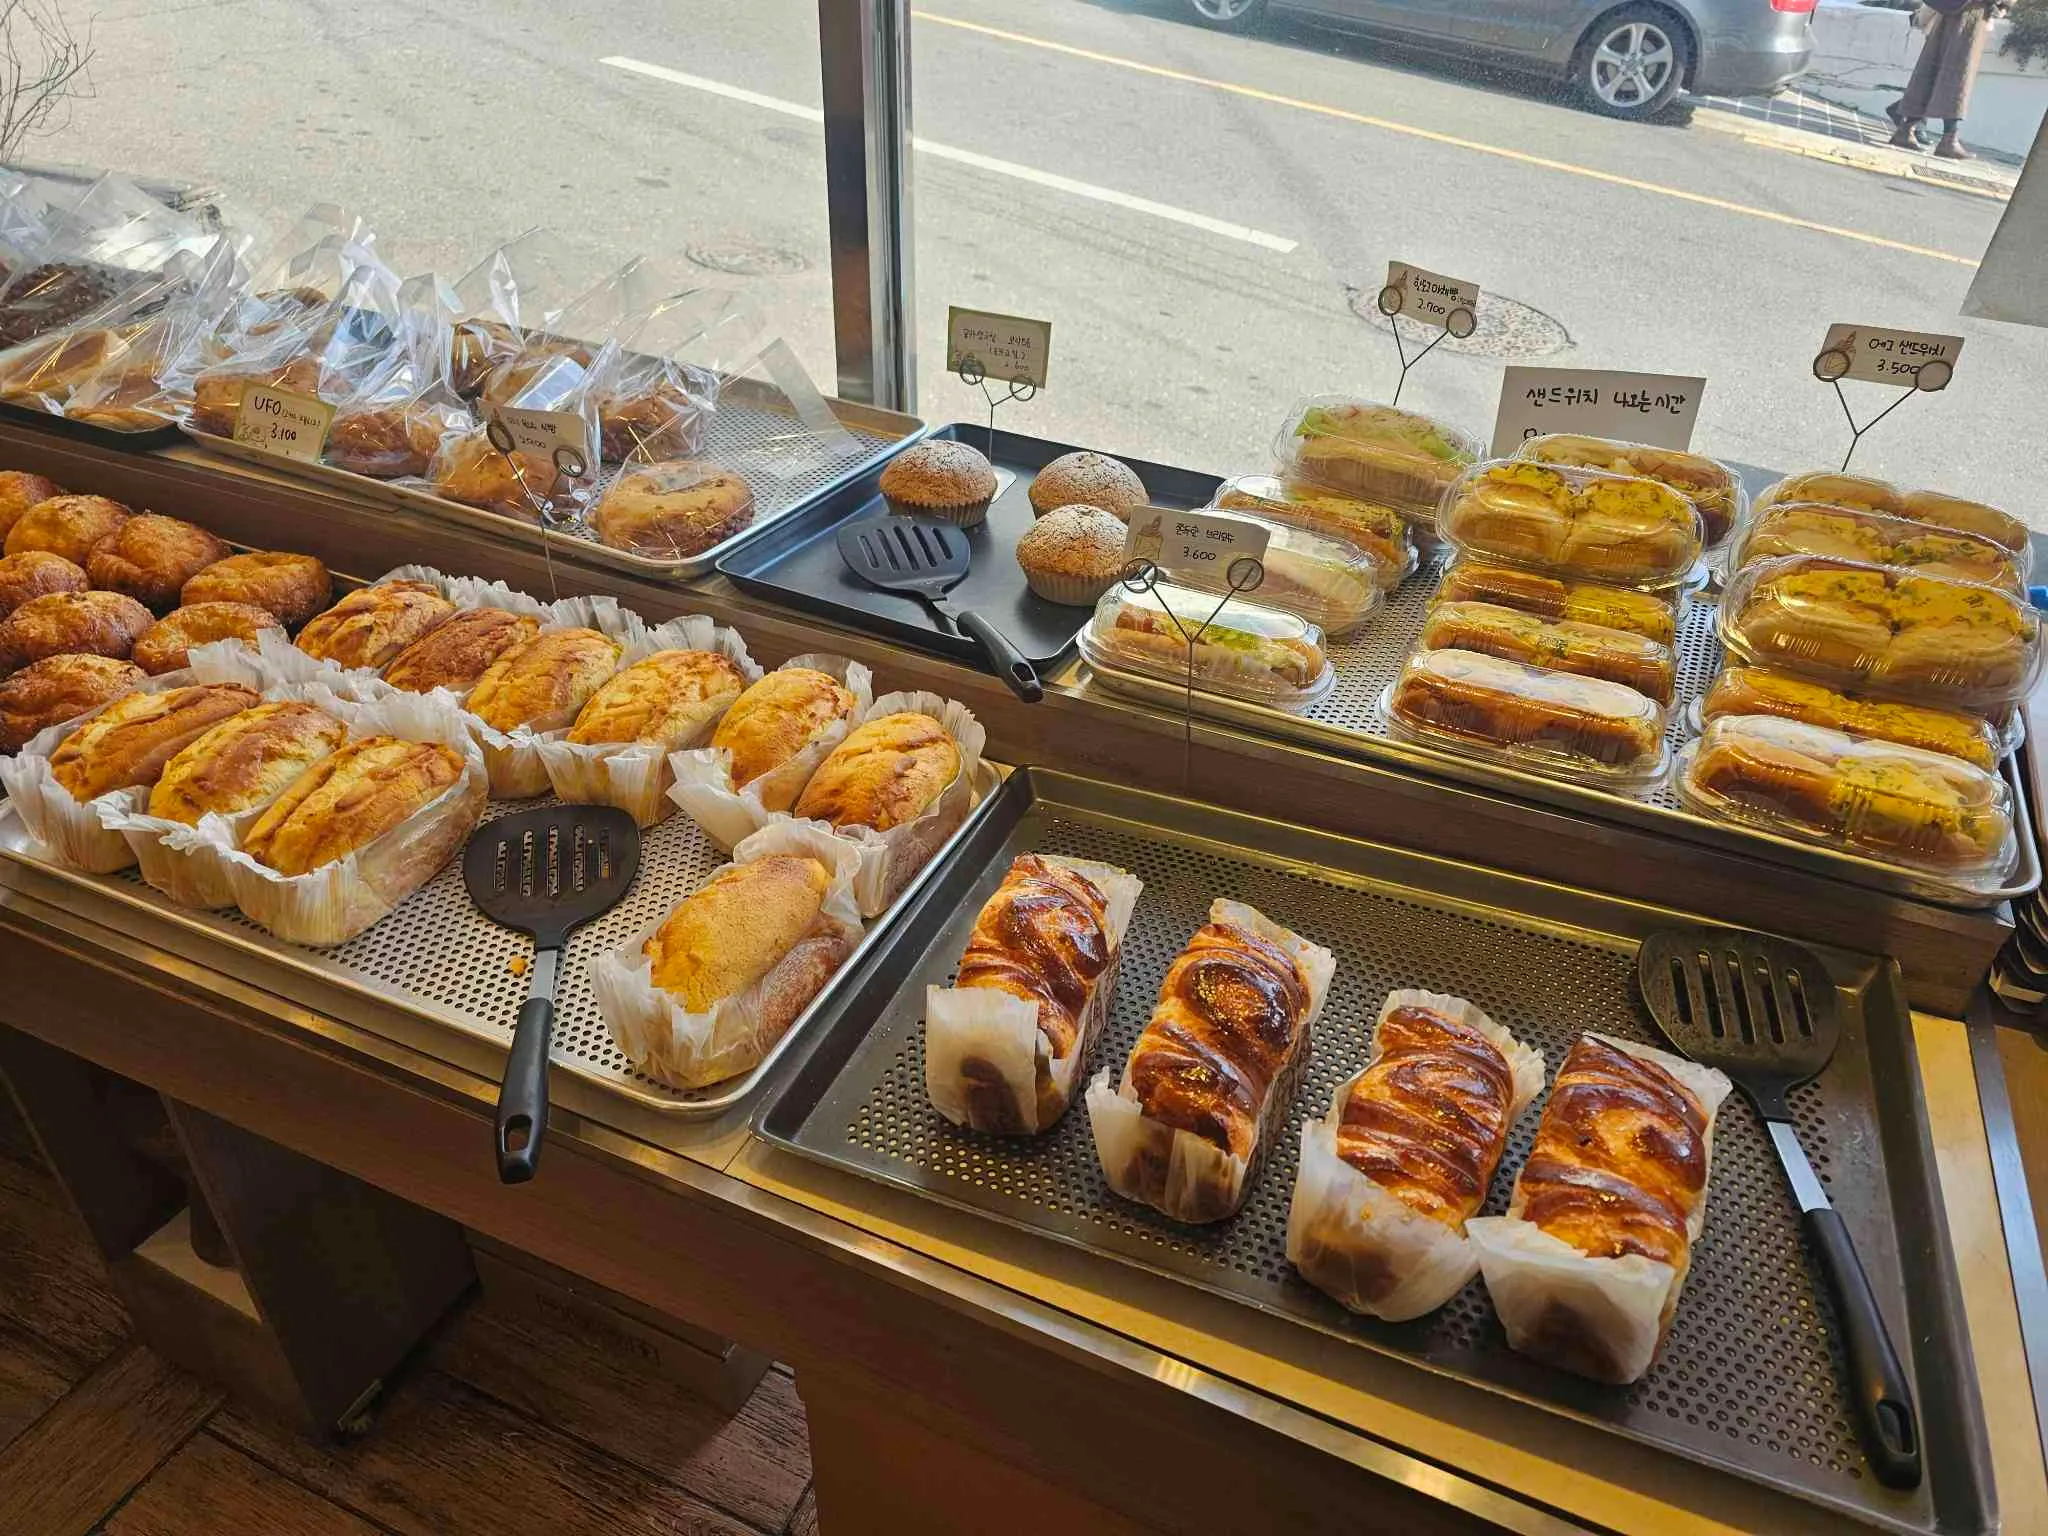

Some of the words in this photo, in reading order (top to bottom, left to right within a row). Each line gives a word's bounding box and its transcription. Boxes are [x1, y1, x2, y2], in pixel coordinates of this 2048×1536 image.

[1417, 298, 1446, 315] 2.700
[1868, 338, 1894, 352] 에그
[1899, 339, 1946, 357] 샌드위치
[1876, 358, 1921, 375] 3.500
[254, 396, 281, 416] UFO
[1526, 387, 1599, 408] 샌드위치
[270, 422, 297, 440] 3.100
[1183, 546, 1217, 561] 3.600
